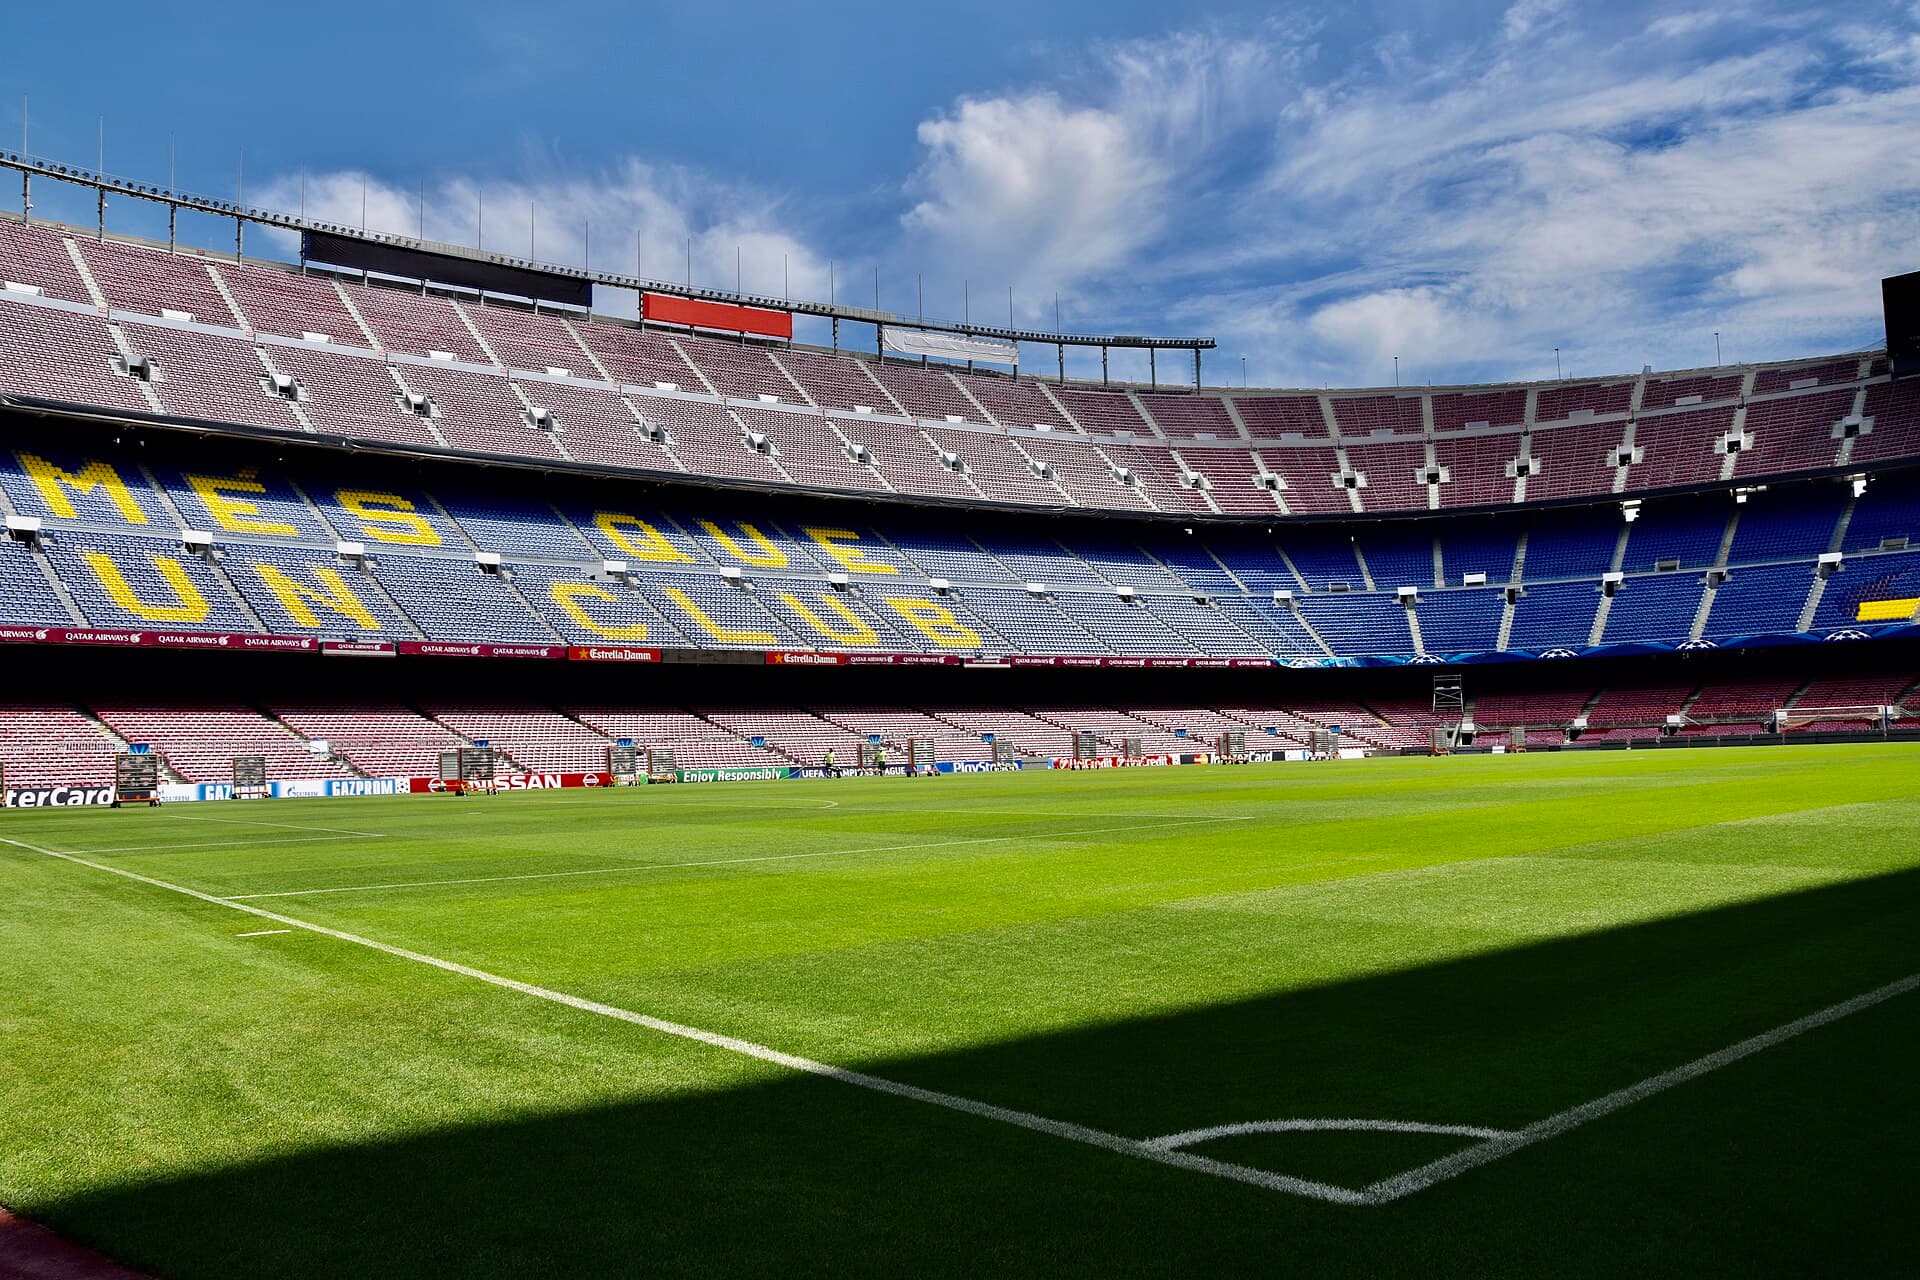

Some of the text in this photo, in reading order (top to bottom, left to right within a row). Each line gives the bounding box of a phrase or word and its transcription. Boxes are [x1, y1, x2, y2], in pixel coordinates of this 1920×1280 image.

[597, 512, 899, 574] QUE
[83, 552, 982, 648] UN CLUB
[65, 632, 129, 641] QATAR AIRWAYS
[158, 635, 217, 644] QATAR AIRWAYS
[244, 638, 300, 647] QATAR AIRWAYS
[421, 645, 470, 654] QATAR AIRWAYS
[493, 647, 513, 655] QATAR
[589, 648, 651, 660] Estrella Damm
[783, 653, 837, 664] Estrella Damm
[684, 767, 782, 783] Enjoy Responsibly
[802, 769, 825, 778] UEFA
[331, 780, 393, 796] GAZPROM
[6, 786, 116, 808] terCard
